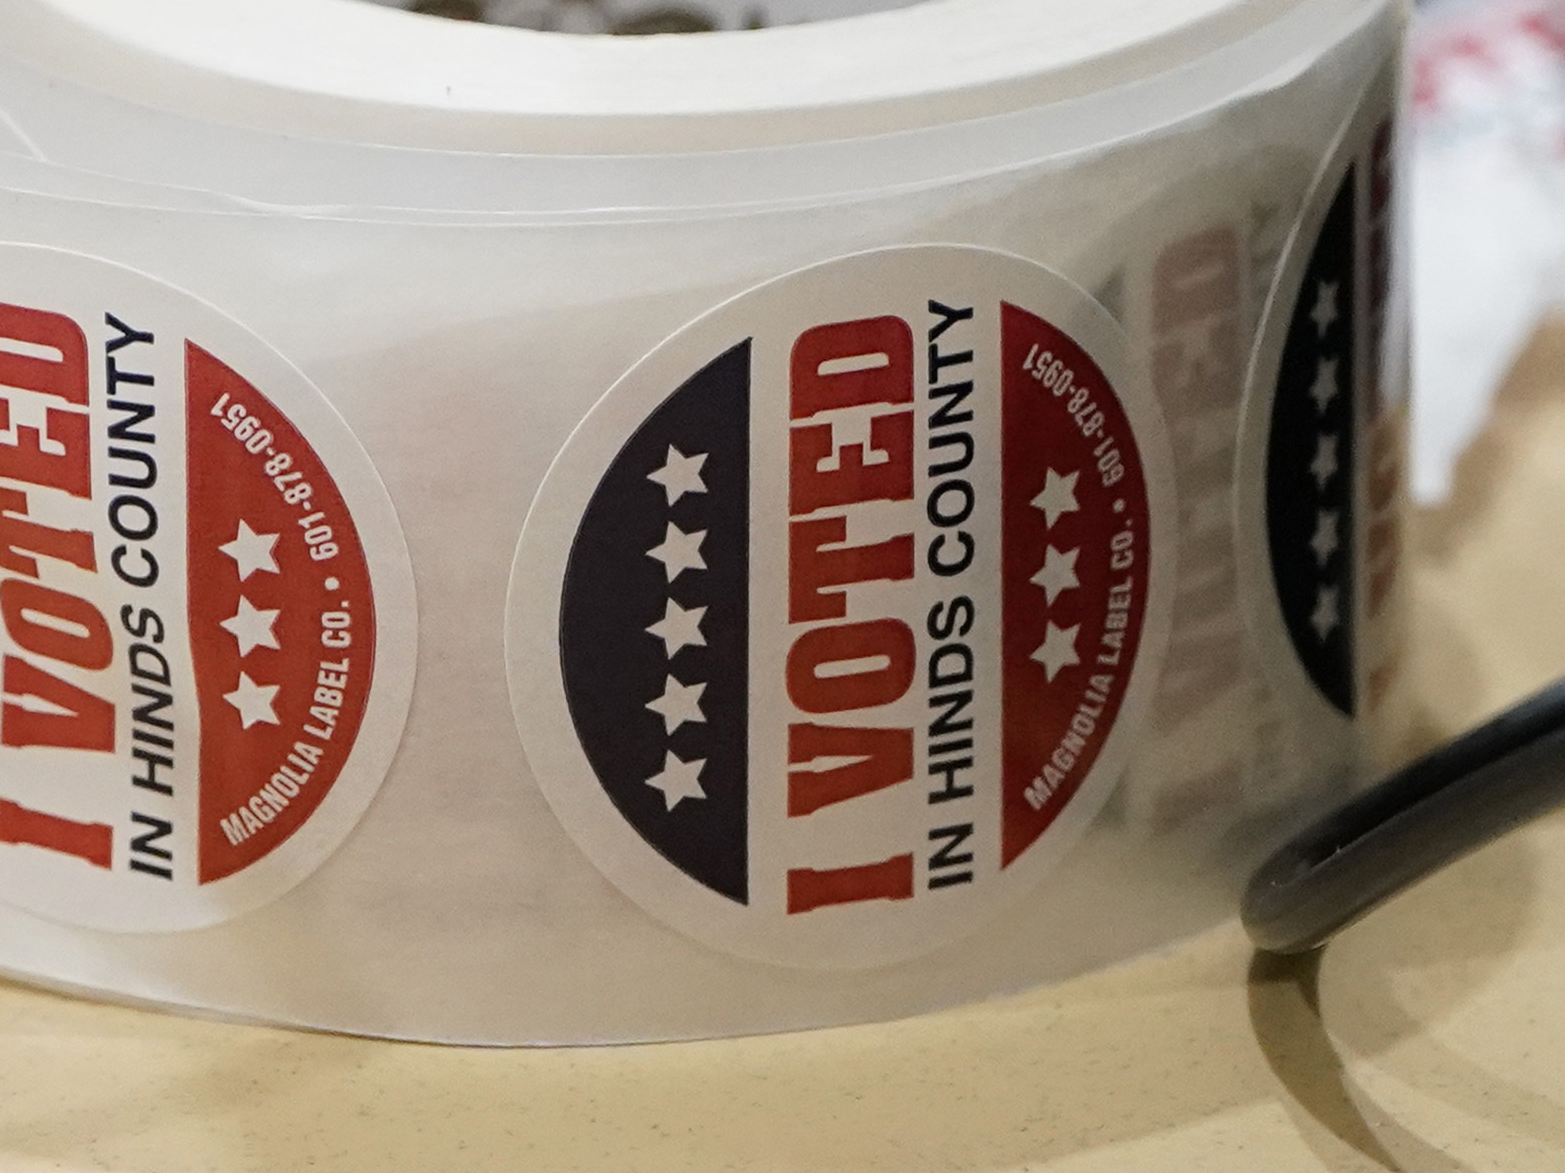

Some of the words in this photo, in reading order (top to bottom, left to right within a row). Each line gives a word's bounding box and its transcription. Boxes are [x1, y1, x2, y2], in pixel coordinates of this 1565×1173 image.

[104, 312, 159, 588] COUNTY
[926, 299, 976, 578] COUNTY
[1021, 343, 1125, 487] 601-878-0951
[209, 392, 340, 562] 601-878-0951
[786, 315, 916, 818] VOTED
[1110, 519, 1135, 571] CO.
[322, 600, 351, 648] CO.
[1097, 575, 1134, 667] LABEL
[120, 603, 174, 796] HINDS
[303, 657, 349, 741] LABEL
[928, 595, 974, 805] HINDS
[1023, 670, 1115, 810] MAGNOLIA
[129, 811, 173, 881] IN
[219, 740, 324, 846] MAGNOLIA
[787, 851, 915, 915] I
[928, 822, 974, 890] IN
